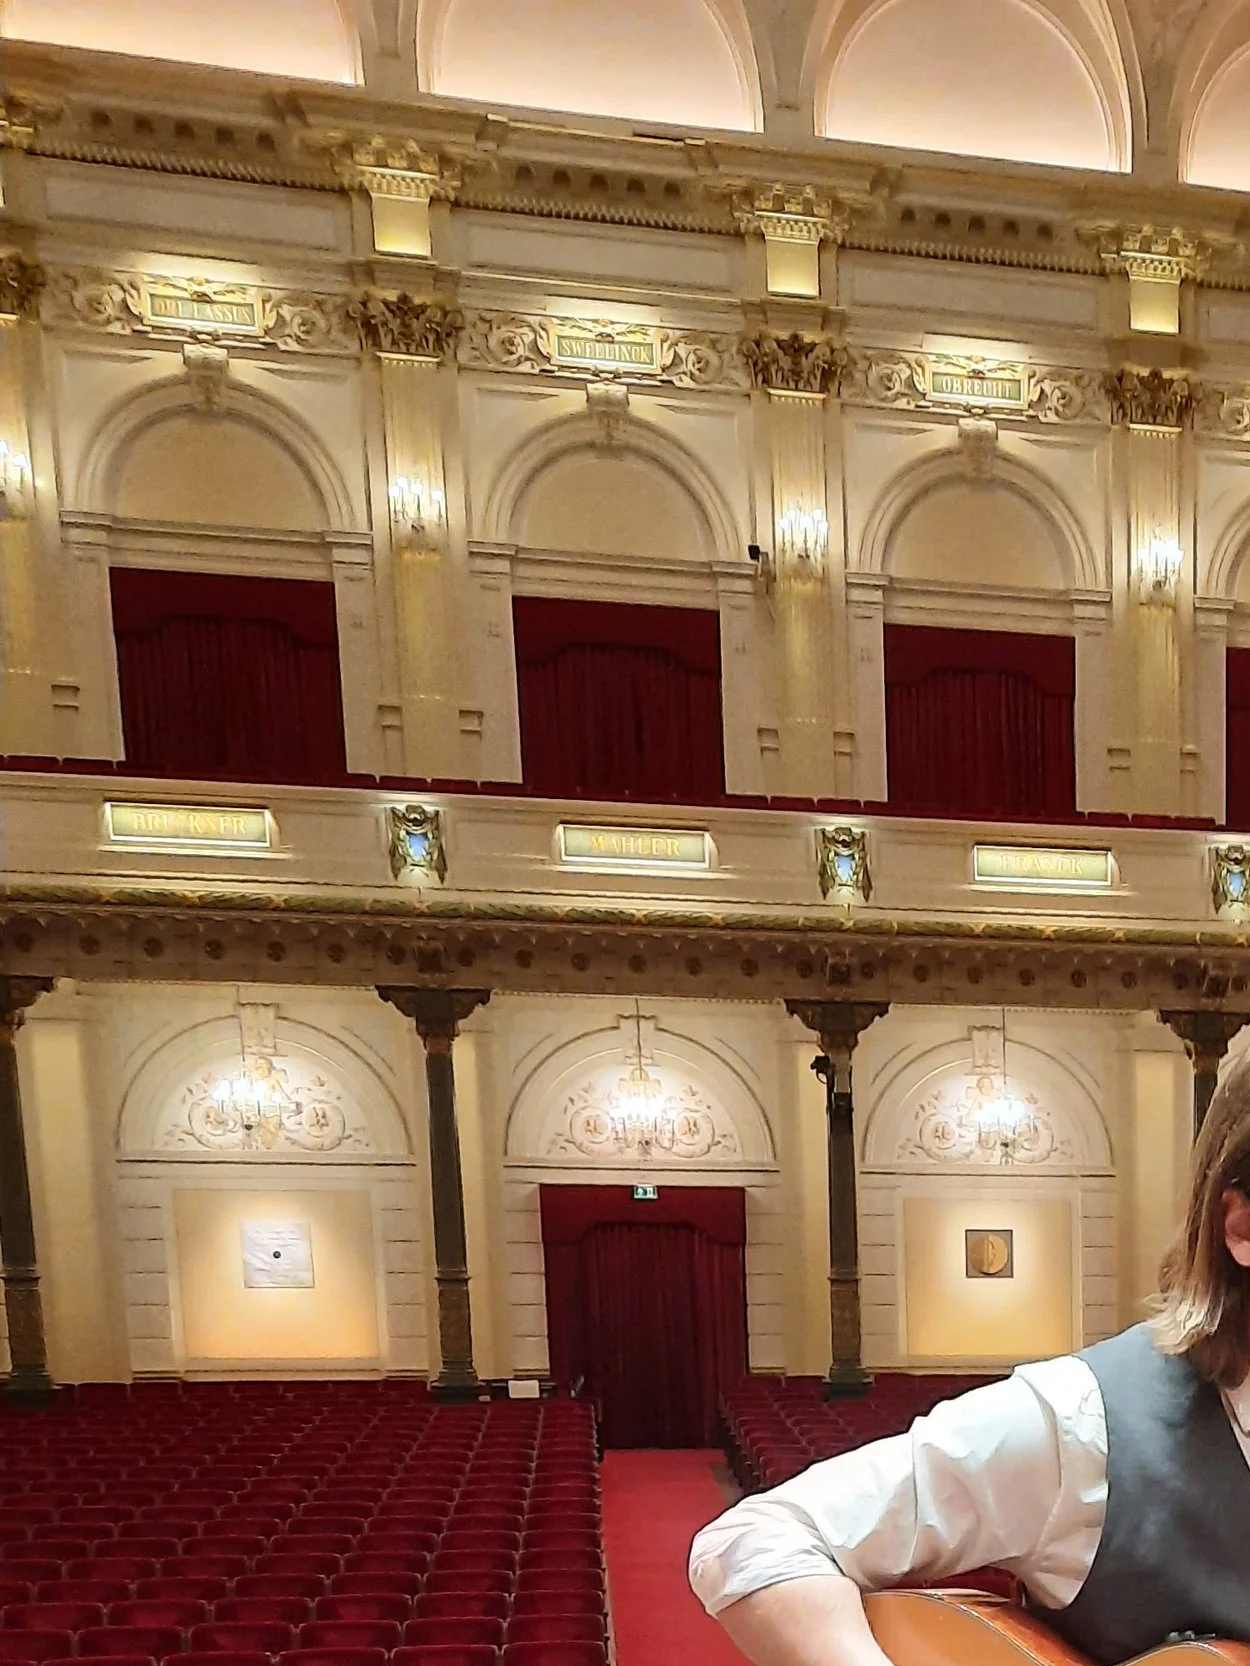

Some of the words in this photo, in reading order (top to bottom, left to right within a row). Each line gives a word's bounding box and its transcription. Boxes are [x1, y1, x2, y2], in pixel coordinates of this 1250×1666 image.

[561, 339, 651, 363] SWEELINCK
[942, 377, 1012, 399] OBRECHT
[132, 812, 247, 834] BRUCKNER
[590, 834, 682, 857] MAHLER
[1000, 854, 1084, 875] FRANCK
